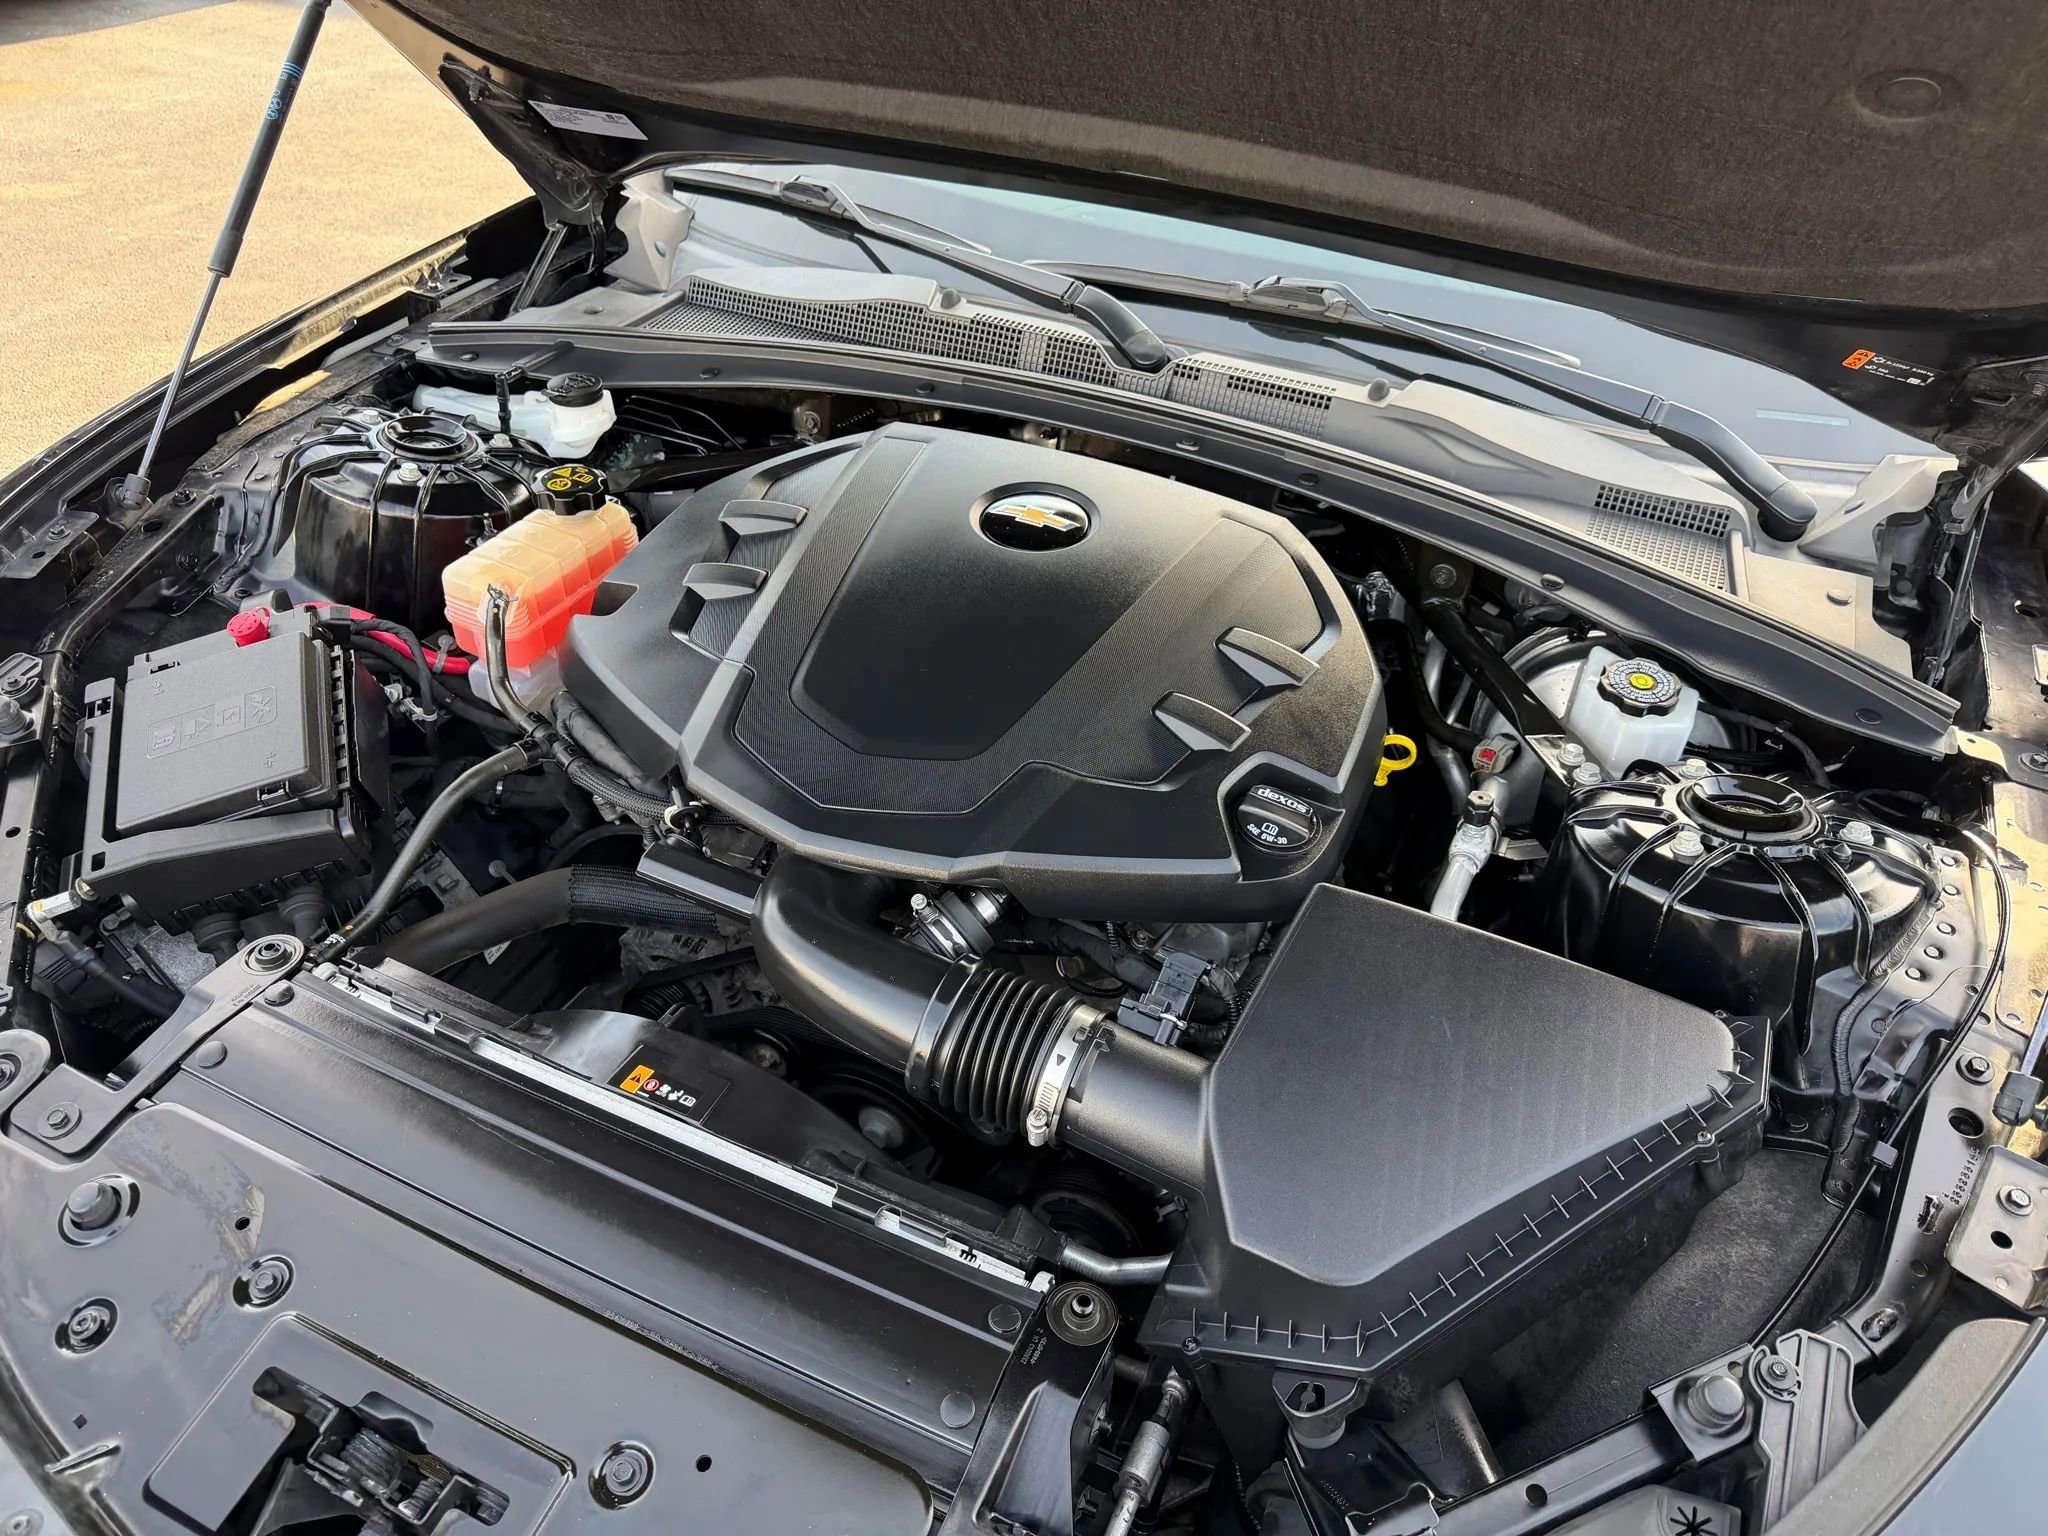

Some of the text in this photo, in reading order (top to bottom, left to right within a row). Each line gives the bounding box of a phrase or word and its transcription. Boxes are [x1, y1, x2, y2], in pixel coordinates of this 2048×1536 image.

[1257, 788, 1309, 813] dexos
[1247, 823, 1288, 845] SAE 5W-30
